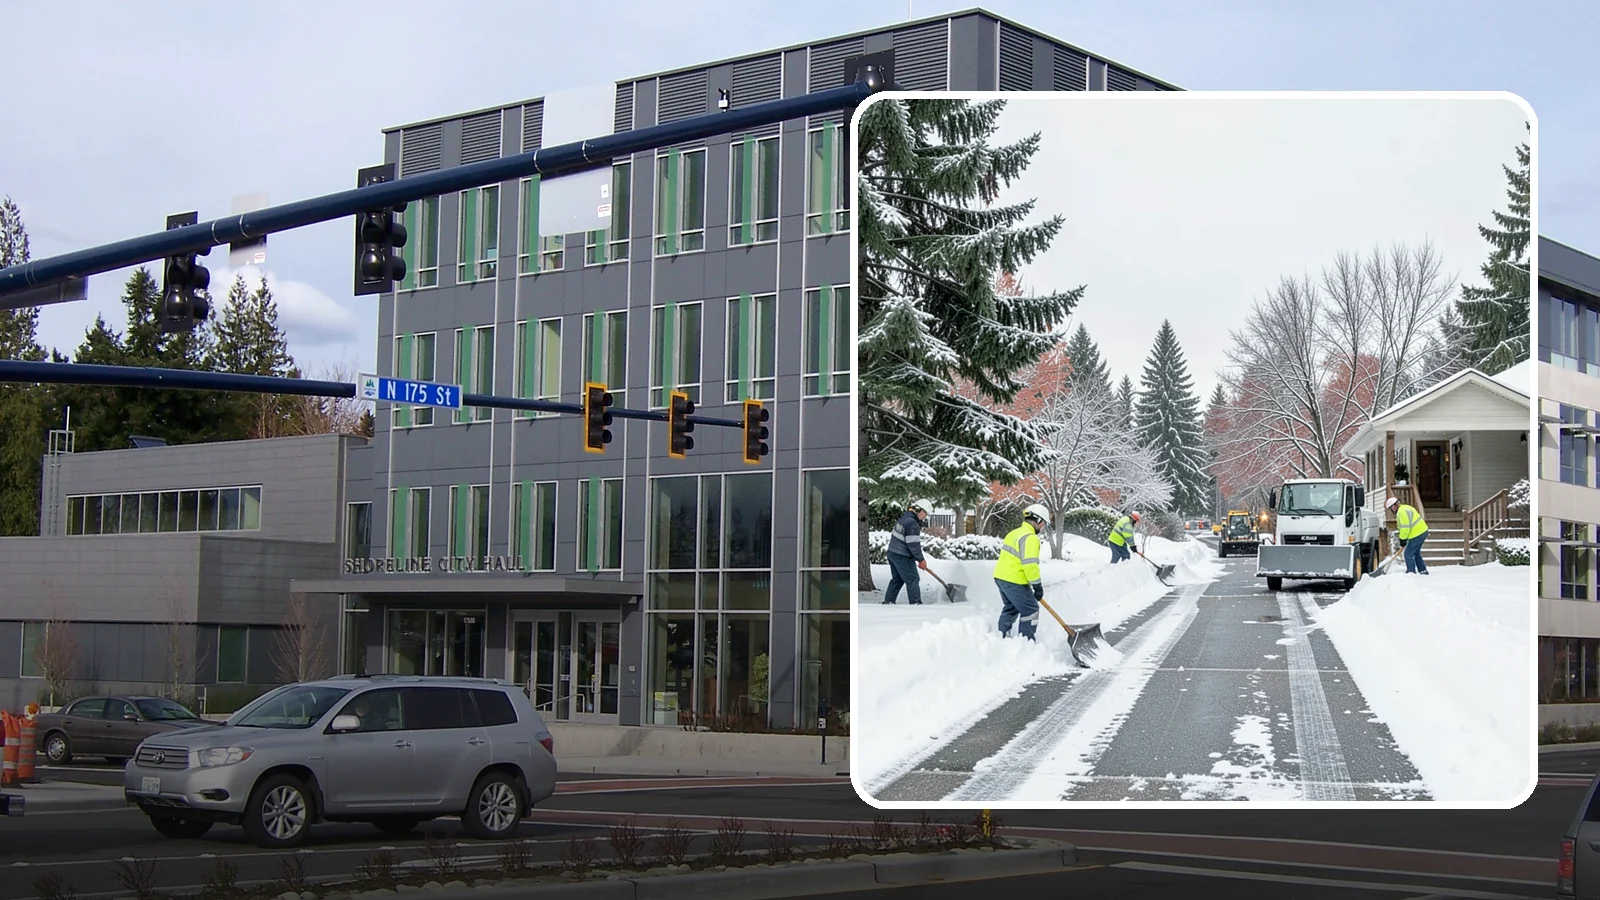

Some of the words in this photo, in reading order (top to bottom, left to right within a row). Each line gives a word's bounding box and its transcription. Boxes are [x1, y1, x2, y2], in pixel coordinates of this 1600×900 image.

[387, 380, 396, 399] N
[405, 382, 427, 403] 175
[436, 386, 451, 406] St
[343, 557, 431, 574] SHORELINE
[438, 557, 475, 572] CITY
[484, 556, 526, 572] HALL
